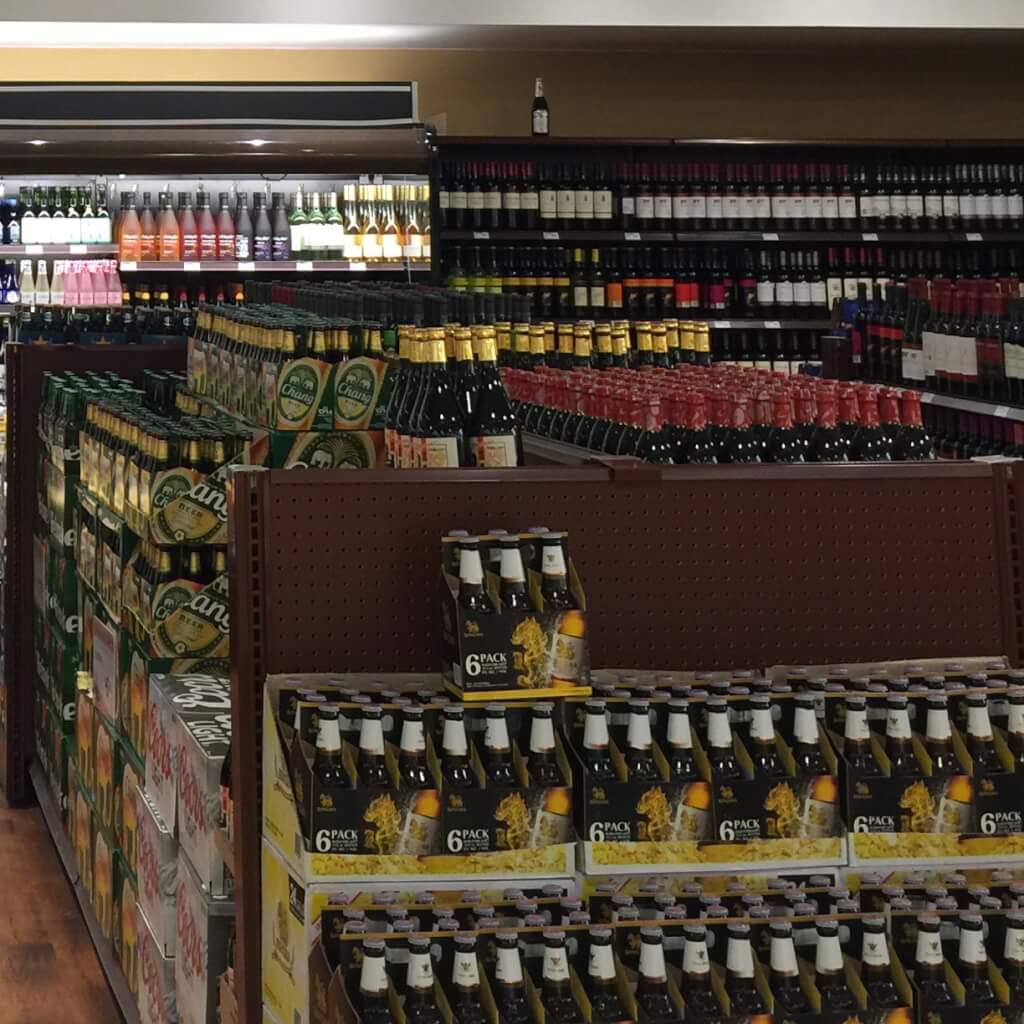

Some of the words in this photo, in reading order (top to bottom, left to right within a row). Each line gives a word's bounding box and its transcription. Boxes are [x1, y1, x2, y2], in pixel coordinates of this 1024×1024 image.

[281, 383, 315, 405] Chang
[337, 381, 372, 402] Chang
[465, 653, 481, 676] 6
[480, 652, 507, 663] PACK
[589, 822, 605, 842] 6
[604, 822, 631, 832] PACK
[719, 820, 735, 840] 6
[734, 819, 760, 830] PACK
[853, 815, 869, 833] 6
[868, 815, 895, 825] PACK
[980, 812, 996, 834] 6
[995, 811, 1022, 822] PACK
[315, 829, 331, 852] 6
[331, 829, 358, 840] PACK
[447, 829, 463, 852] 6
[462, 828, 489, 840] PACK
